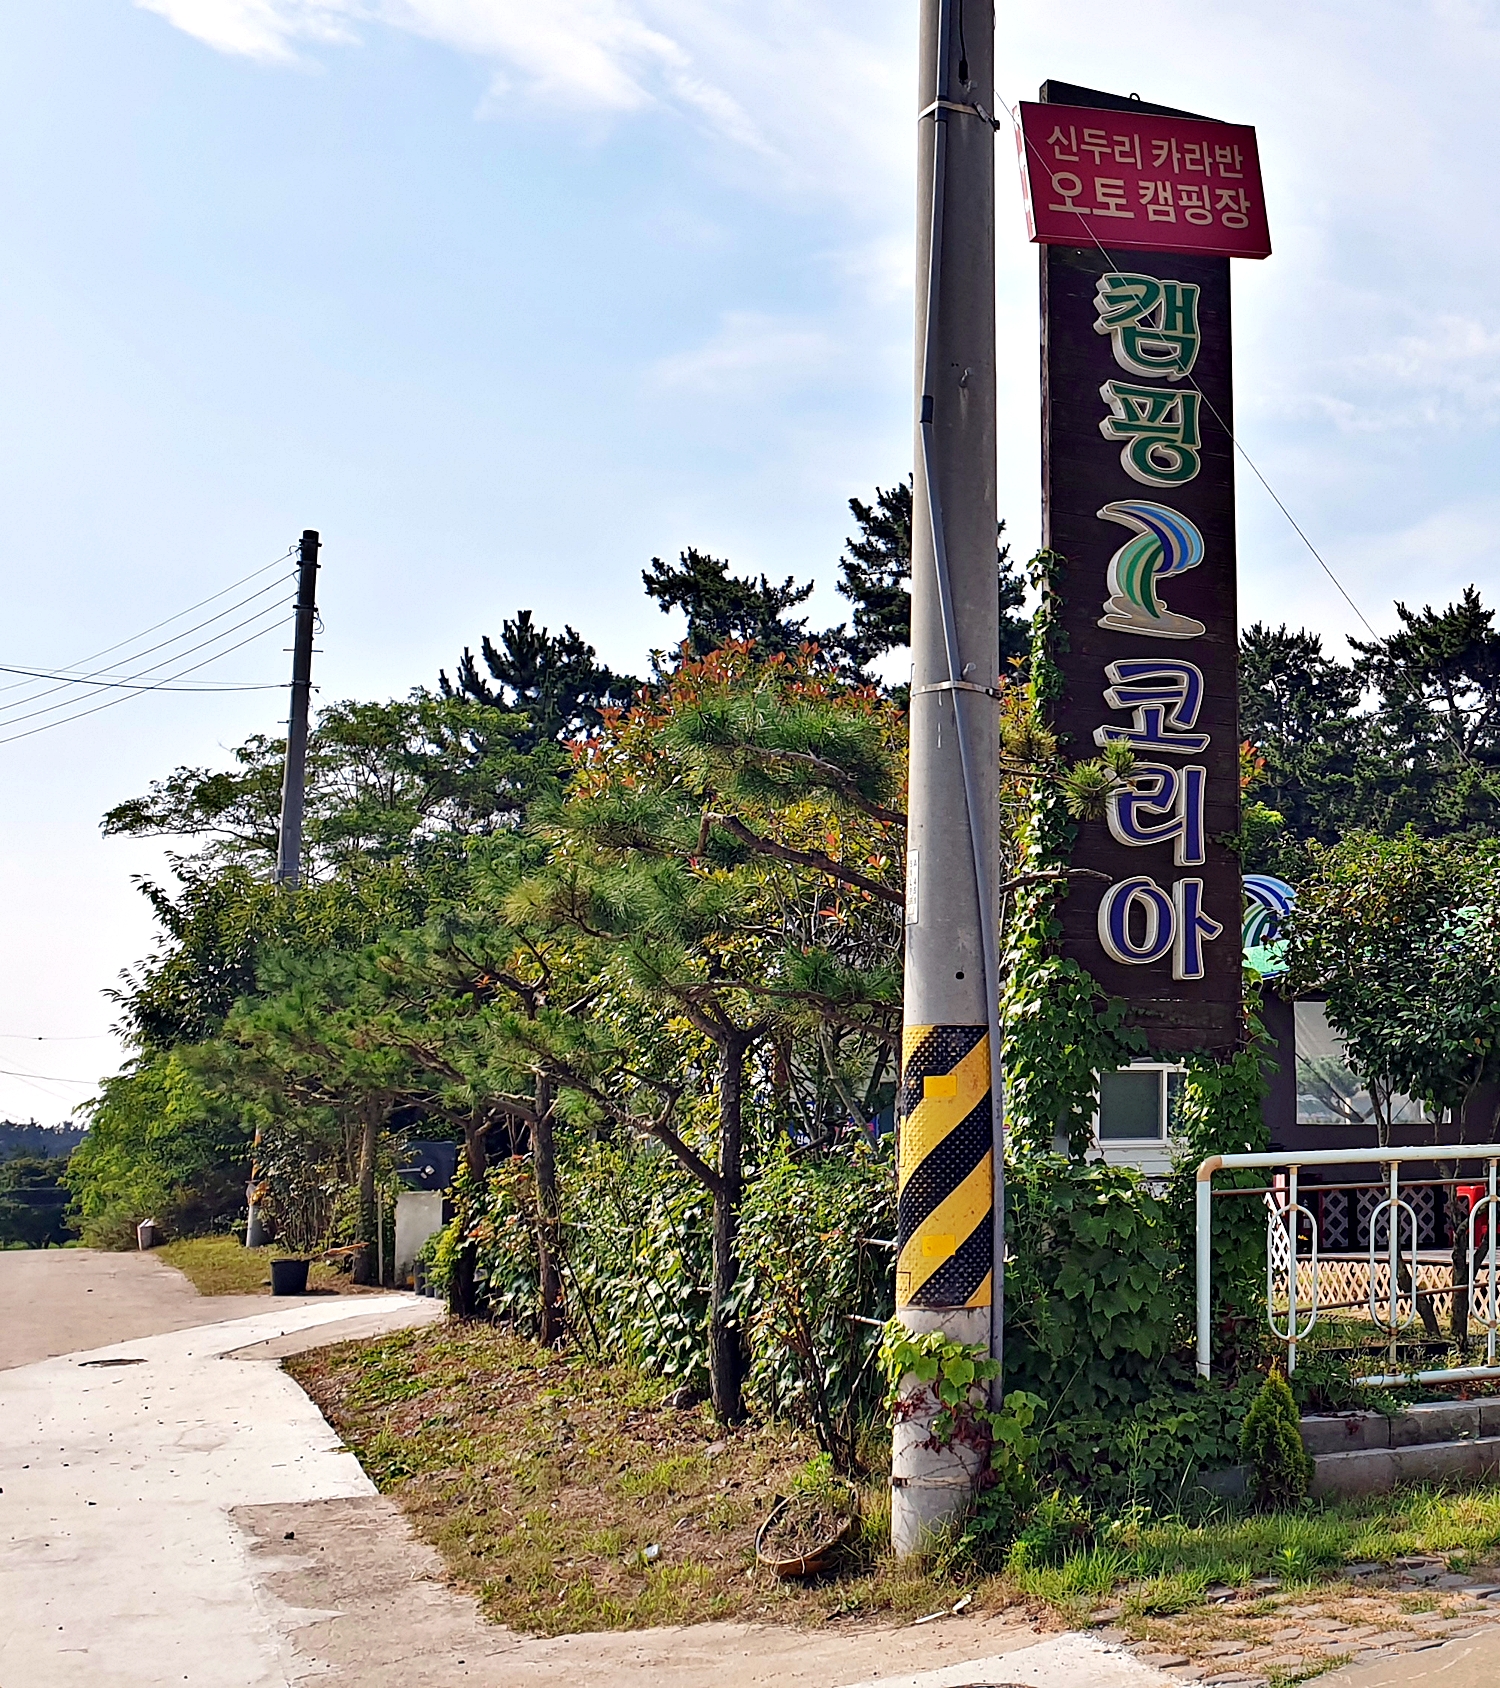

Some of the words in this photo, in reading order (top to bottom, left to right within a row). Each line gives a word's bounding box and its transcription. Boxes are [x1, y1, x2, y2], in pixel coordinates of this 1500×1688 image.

[1047, 125, 1142, 170] 신두리
[1151, 137, 1244, 179] 카라반
[1048, 172, 1135, 219] 오토
[1138, 180, 1251, 229] 캠핑장
[1094, 273, 1201, 488] 캠핑
[1094, 657, 1223, 981] 코리아
